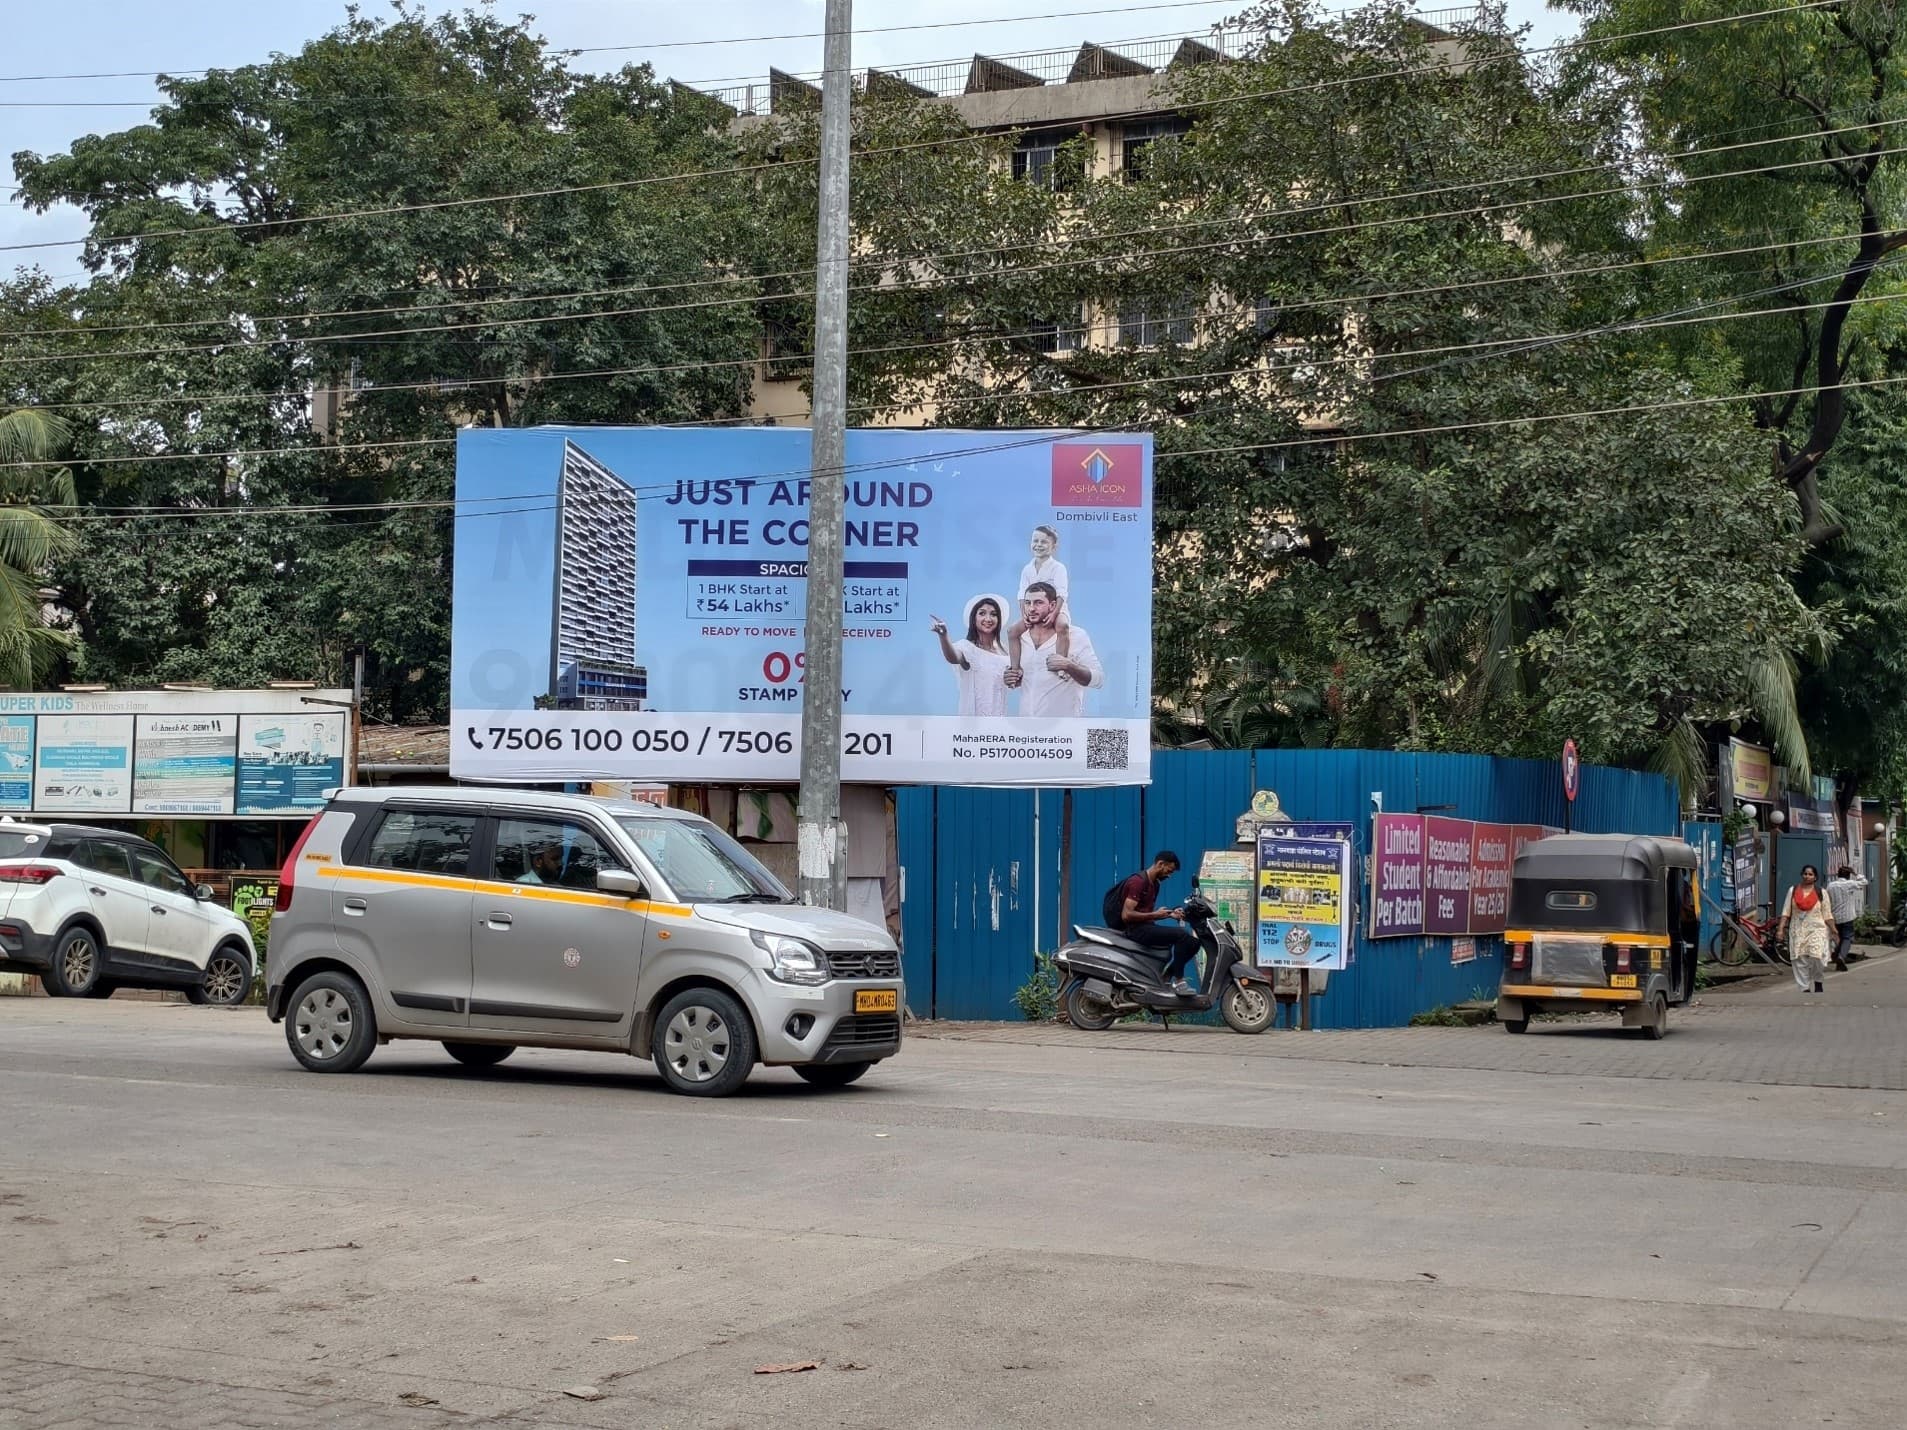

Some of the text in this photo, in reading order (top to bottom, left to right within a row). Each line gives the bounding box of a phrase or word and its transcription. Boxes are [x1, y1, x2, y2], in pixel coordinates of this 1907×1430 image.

[665, 480, 933, 508] JUST ARUND
[1069, 484, 1126, 494] ASHA ICON
[1056, 511, 1138, 522] Dombivli East
[678, 519, 919, 547] THE CONER
[698, 584, 788, 595] 1 BHK Start at
[851, 585, 883, 597] Start
[885, 586, 900, 597] at
[702, 626, 740, 636] READY
[744, 627, 759, 636] TO
[763, 628, 797, 637] MOVE
[842, 629, 892, 638] ECEIVED
[0, 696, 36, 711] UPER
[40, 696, 74, 711] KIDS
[738, 687, 798, 701] STAMP
[488, 726, 892, 756] 7506 100 050 / 7506 201
[952, 734, 1073, 745] MahaRERA Registeration
[952, 747, 1073, 760] No. P51700014509
[1385, 824, 1421, 855] Limited
[1429, 836, 1470, 863] Reasonable
[1478, 837, 1506, 862] Admission
[1383, 859, 1421, 890] Student
[1426, 864, 1470, 891] & Affordable
[1472, 866, 1482, 888] For
[1376, 895, 1422, 927] Per Batch
[1438, 895, 1454, 919] Fees
[1474, 893, 1487, 915] Year
